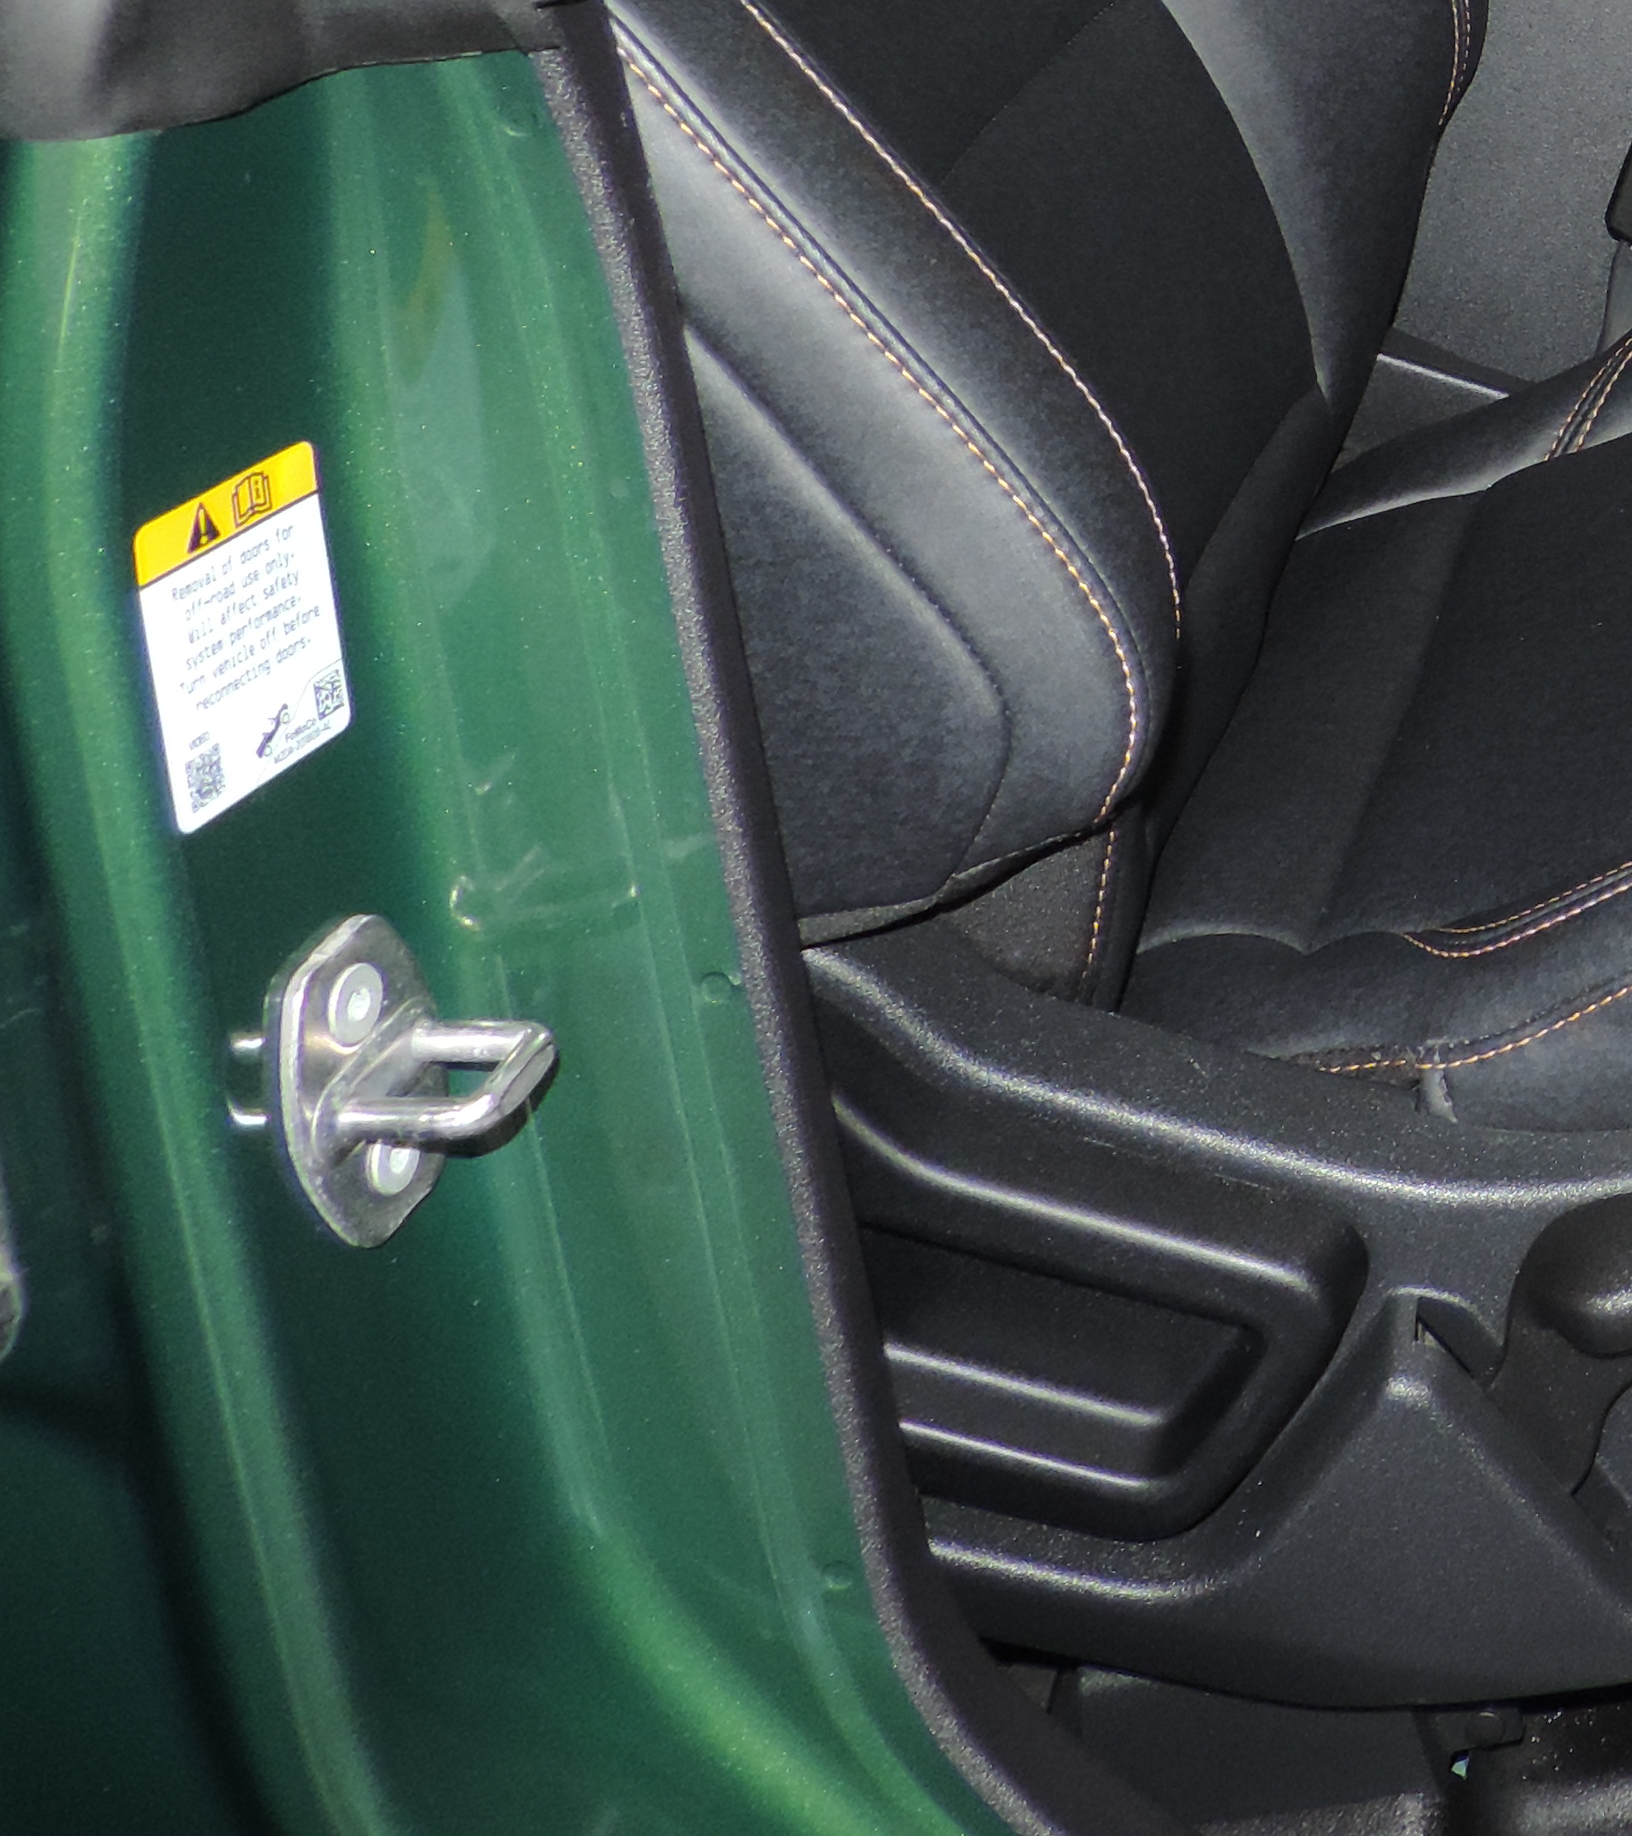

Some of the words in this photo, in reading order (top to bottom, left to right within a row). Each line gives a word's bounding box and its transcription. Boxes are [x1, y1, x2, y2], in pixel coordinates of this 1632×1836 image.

[172, 566, 216, 601] Removal
[222, 555, 232, 576] of
[240, 539, 270, 565] doors
[276, 525, 293, 543] for
[185, 582, 235, 621] off-road
[242, 570, 259, 588] use
[266, 552, 294, 575] only.
[186, 639, 223, 670] system
[230, 596, 301, 646] performance.
[188, 618, 213, 644] Will
[221, 595, 256, 625] affect
[263, 571, 298, 600] safety
[180, 675, 206, 694] Turn
[213, 644, 255, 678] vehicle
[260, 626, 276, 649] off
[283, 605, 320, 635] before
[196, 660, 271, 710] reconnecting
[276, 637, 311, 664] doors.
